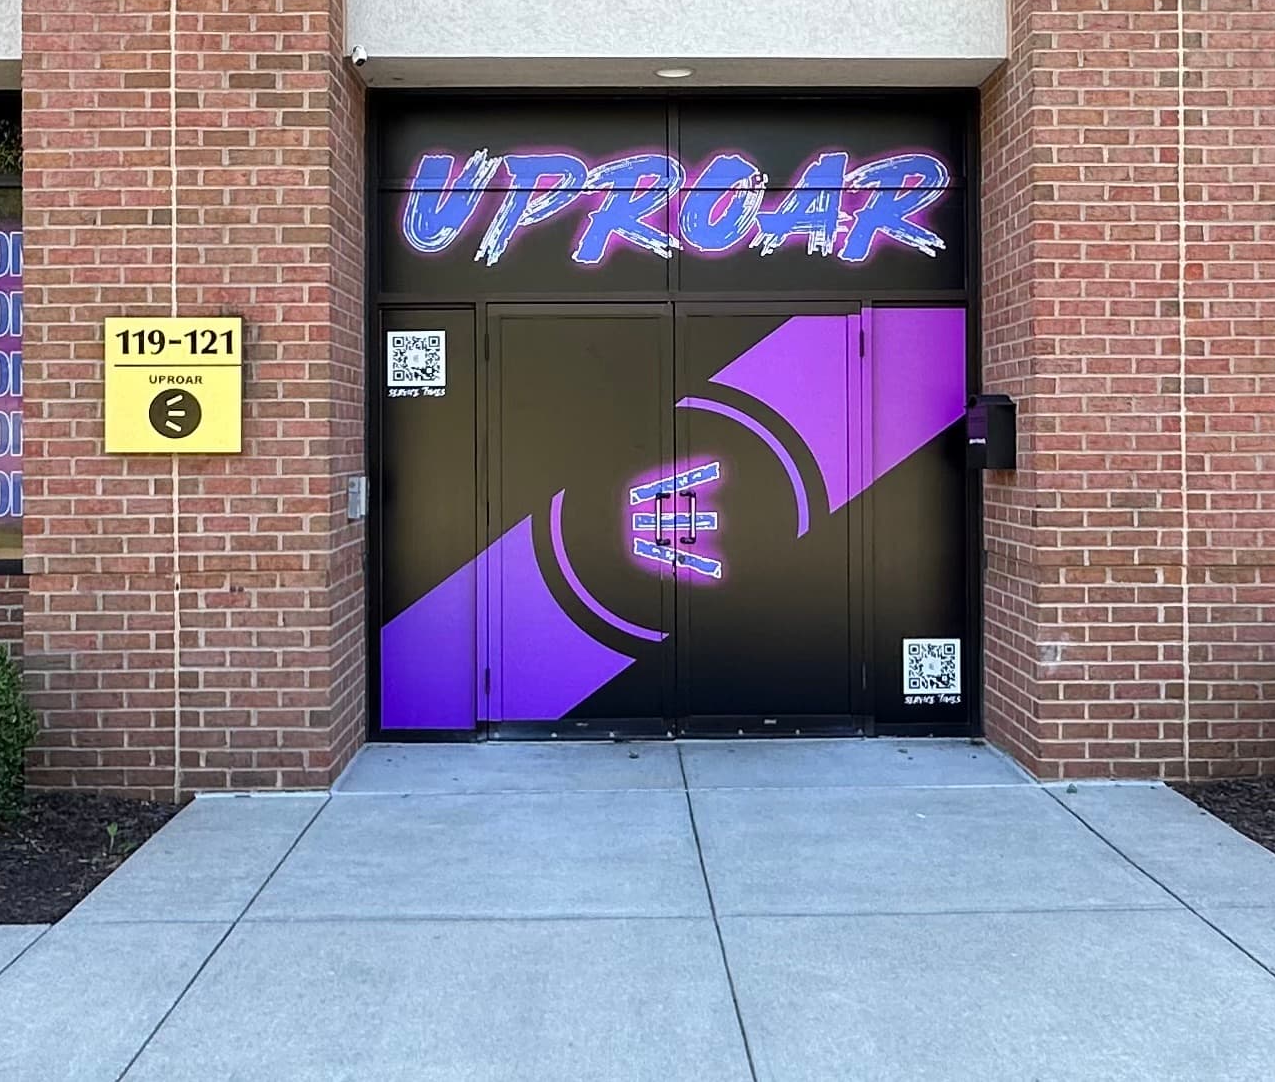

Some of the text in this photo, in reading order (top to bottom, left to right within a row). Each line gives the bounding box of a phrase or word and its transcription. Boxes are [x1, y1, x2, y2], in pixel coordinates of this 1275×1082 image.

[401, 149, 951, 267] UPROAR
[115, 329, 233, 355] 119-121
[148, 374, 203, 384] UPROAR
